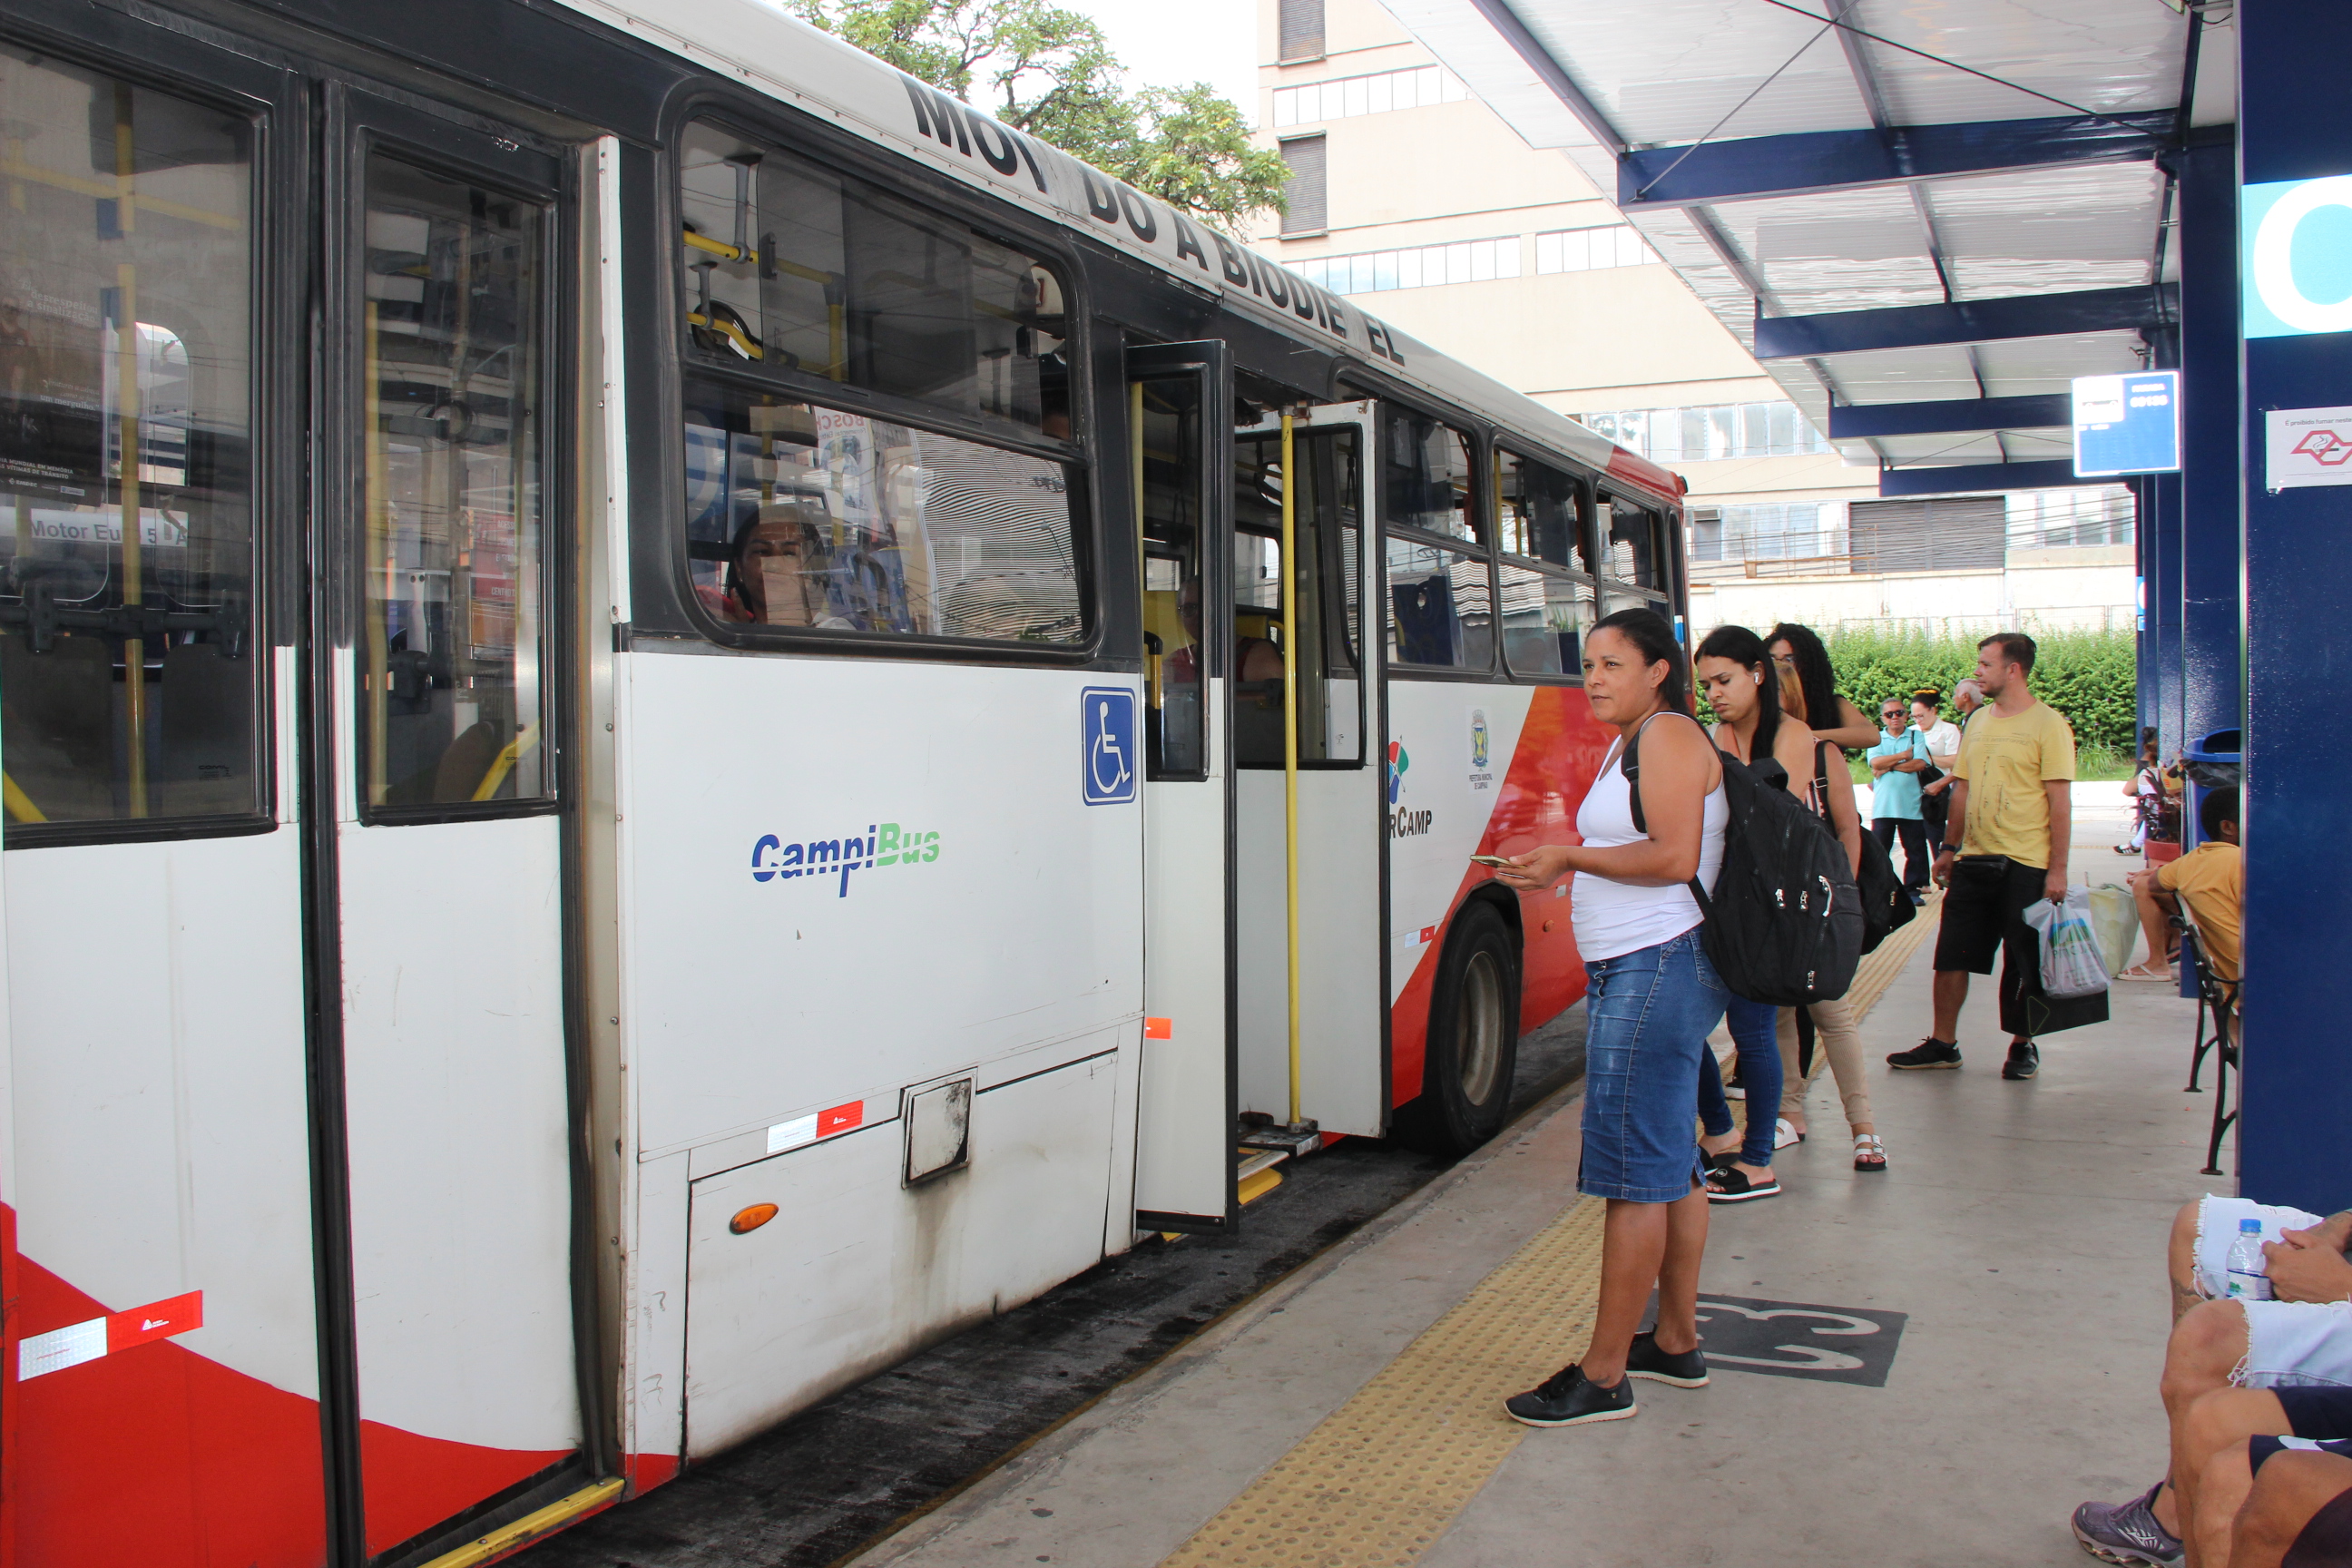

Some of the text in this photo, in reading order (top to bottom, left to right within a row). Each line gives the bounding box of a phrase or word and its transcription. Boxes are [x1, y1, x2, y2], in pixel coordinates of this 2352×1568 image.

[1170, 210, 1209, 272] A
[1208, 231, 1406, 368] BIODIEEL
[40, 395, 53, 403] um
[6, 465, 31, 474] VÍTIMAS
[41, 470, 69, 480] TRÂNSITO
[9, 459, 36, 468] MUNDIAL
[47, 466, 74, 475] MEMÓRIA
[31, 520, 88, 540] Motor
[147, 528, 157, 544] 5
[751, 822, 941, 898] CampiBus
